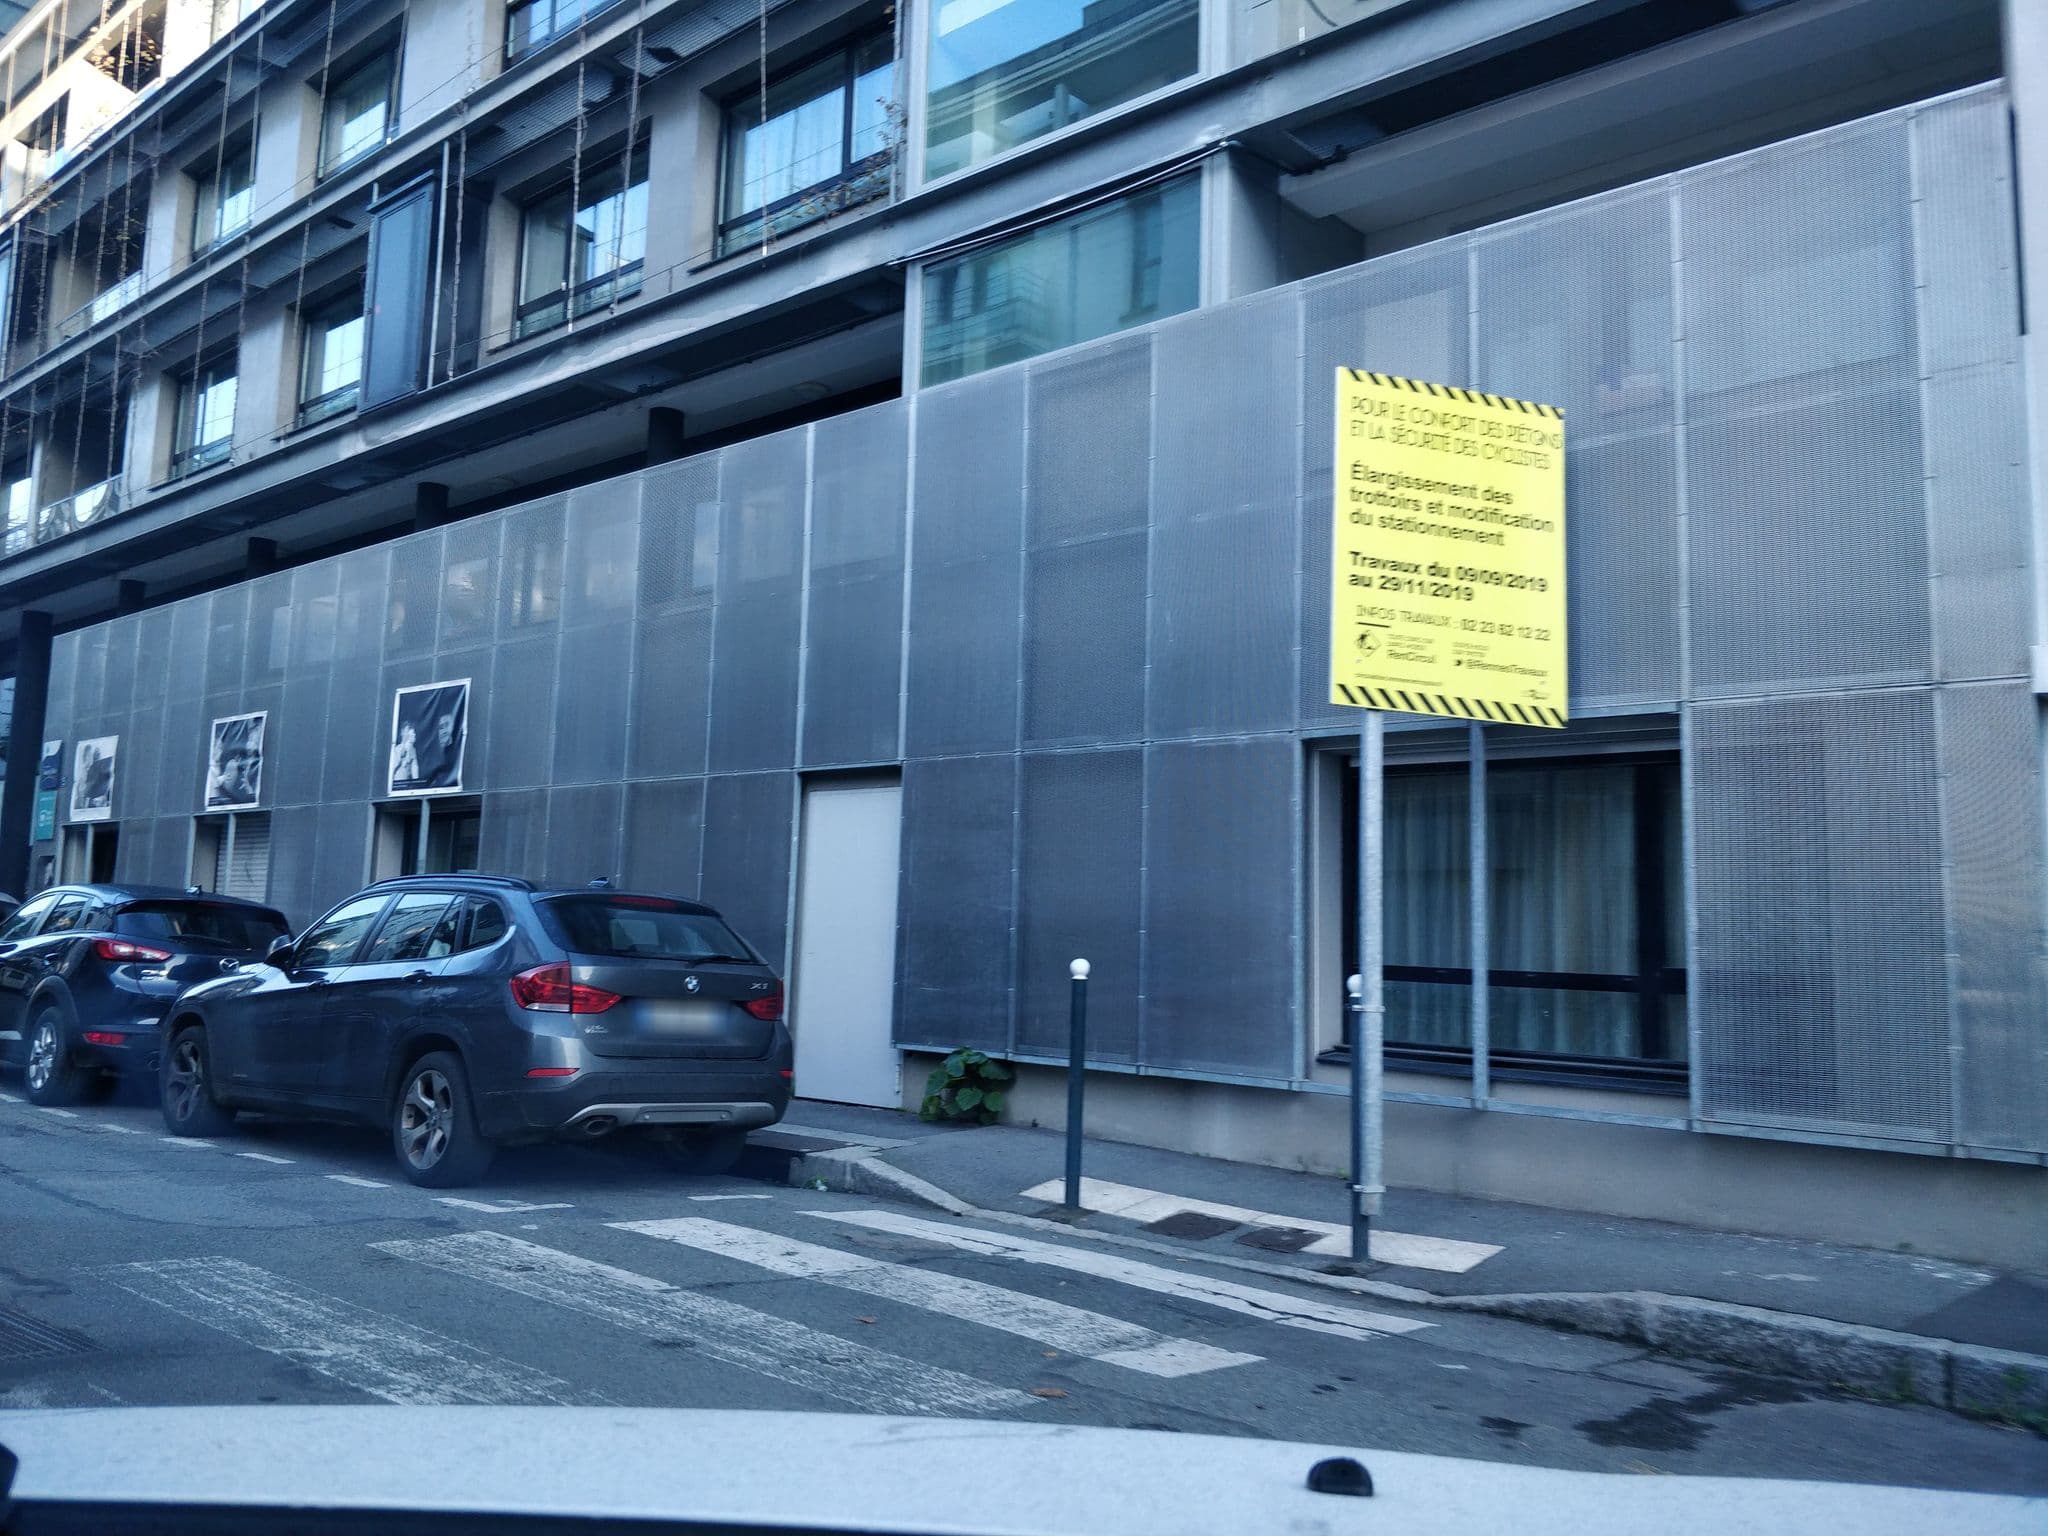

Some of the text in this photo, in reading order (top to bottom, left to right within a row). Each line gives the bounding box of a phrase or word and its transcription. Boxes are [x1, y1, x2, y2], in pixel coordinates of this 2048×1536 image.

[1351, 419, 1365, 437] ET
[1368, 421, 1385, 440] LA
[1409, 406, 1475, 434] CONFORT
[1350, 460, 1513, 505] Élargissement des
[1349, 508, 1504, 546] du stationnement
[1350, 487, 1554, 533] trottoirs et modification
[1349, 550, 1549, 593] Travaux du 09/09/2019
[1349, 573, 1474, 601] au 29/11/2019
